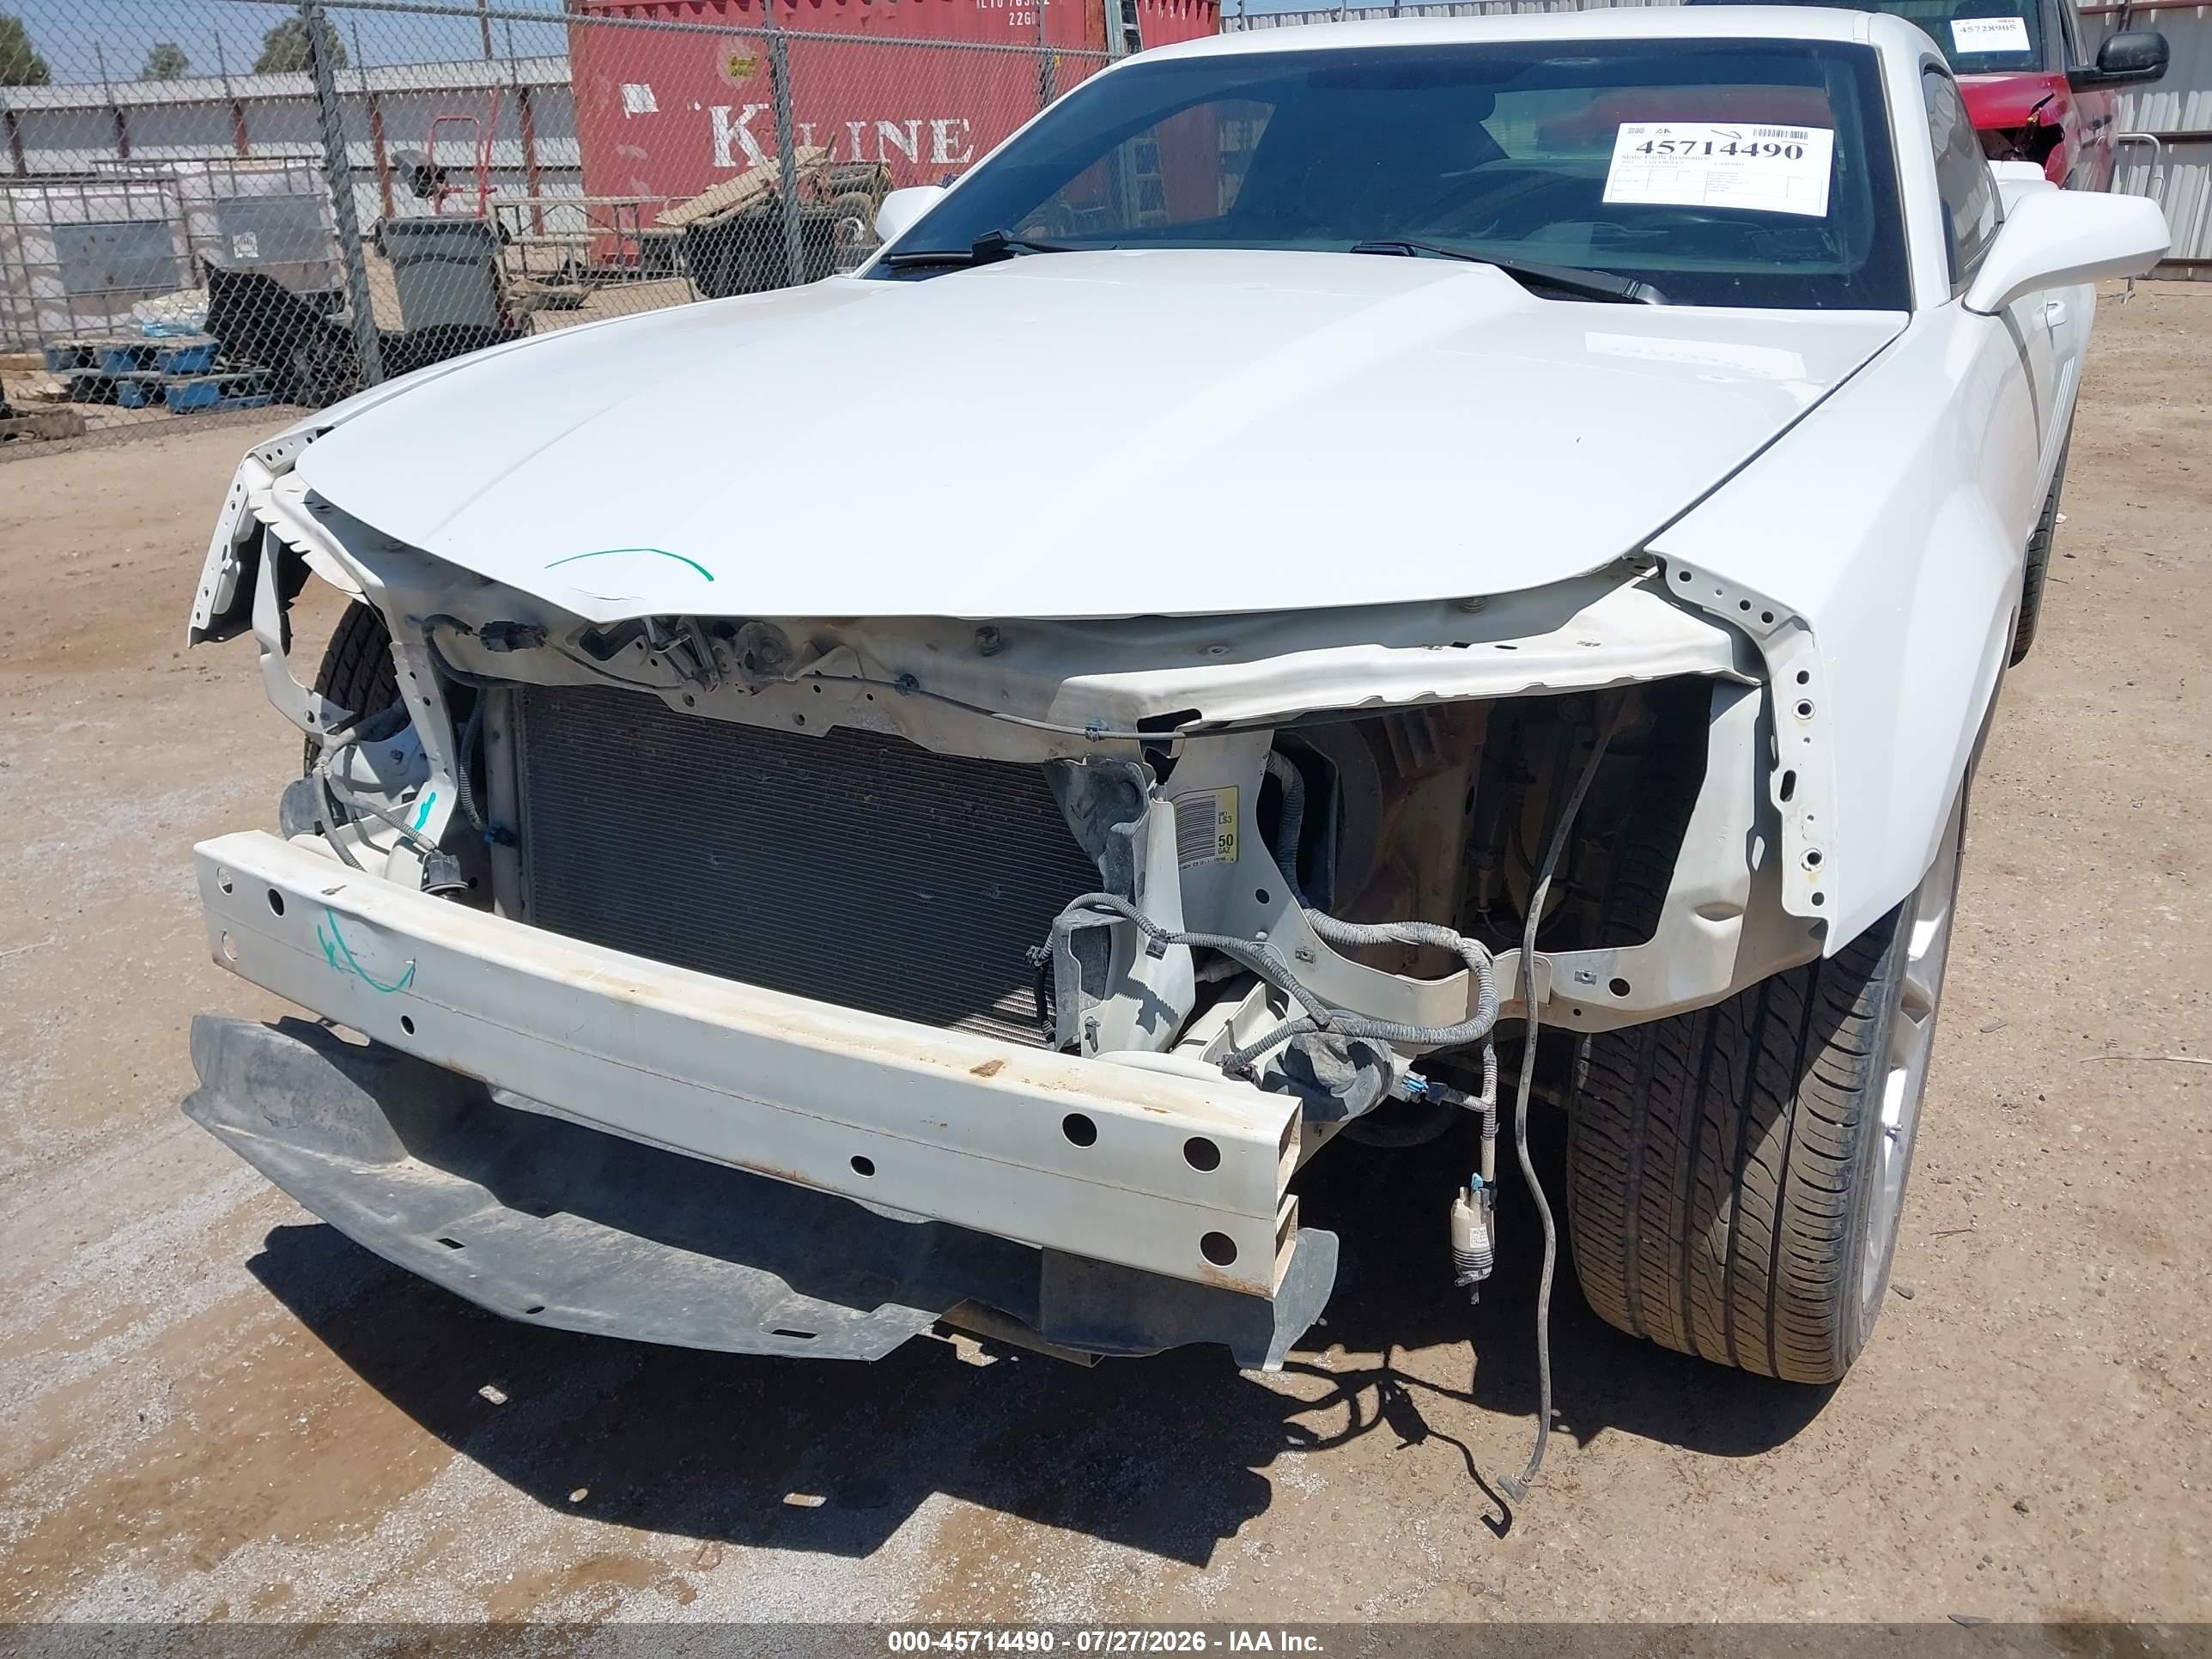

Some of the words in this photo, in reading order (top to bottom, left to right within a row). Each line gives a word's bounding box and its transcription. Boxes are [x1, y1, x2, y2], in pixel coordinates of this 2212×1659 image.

[1960, 24, 2016, 33] 45728905
[1635, 140, 1804, 161] 45714490
[1218, 833, 1234, 847] 50
